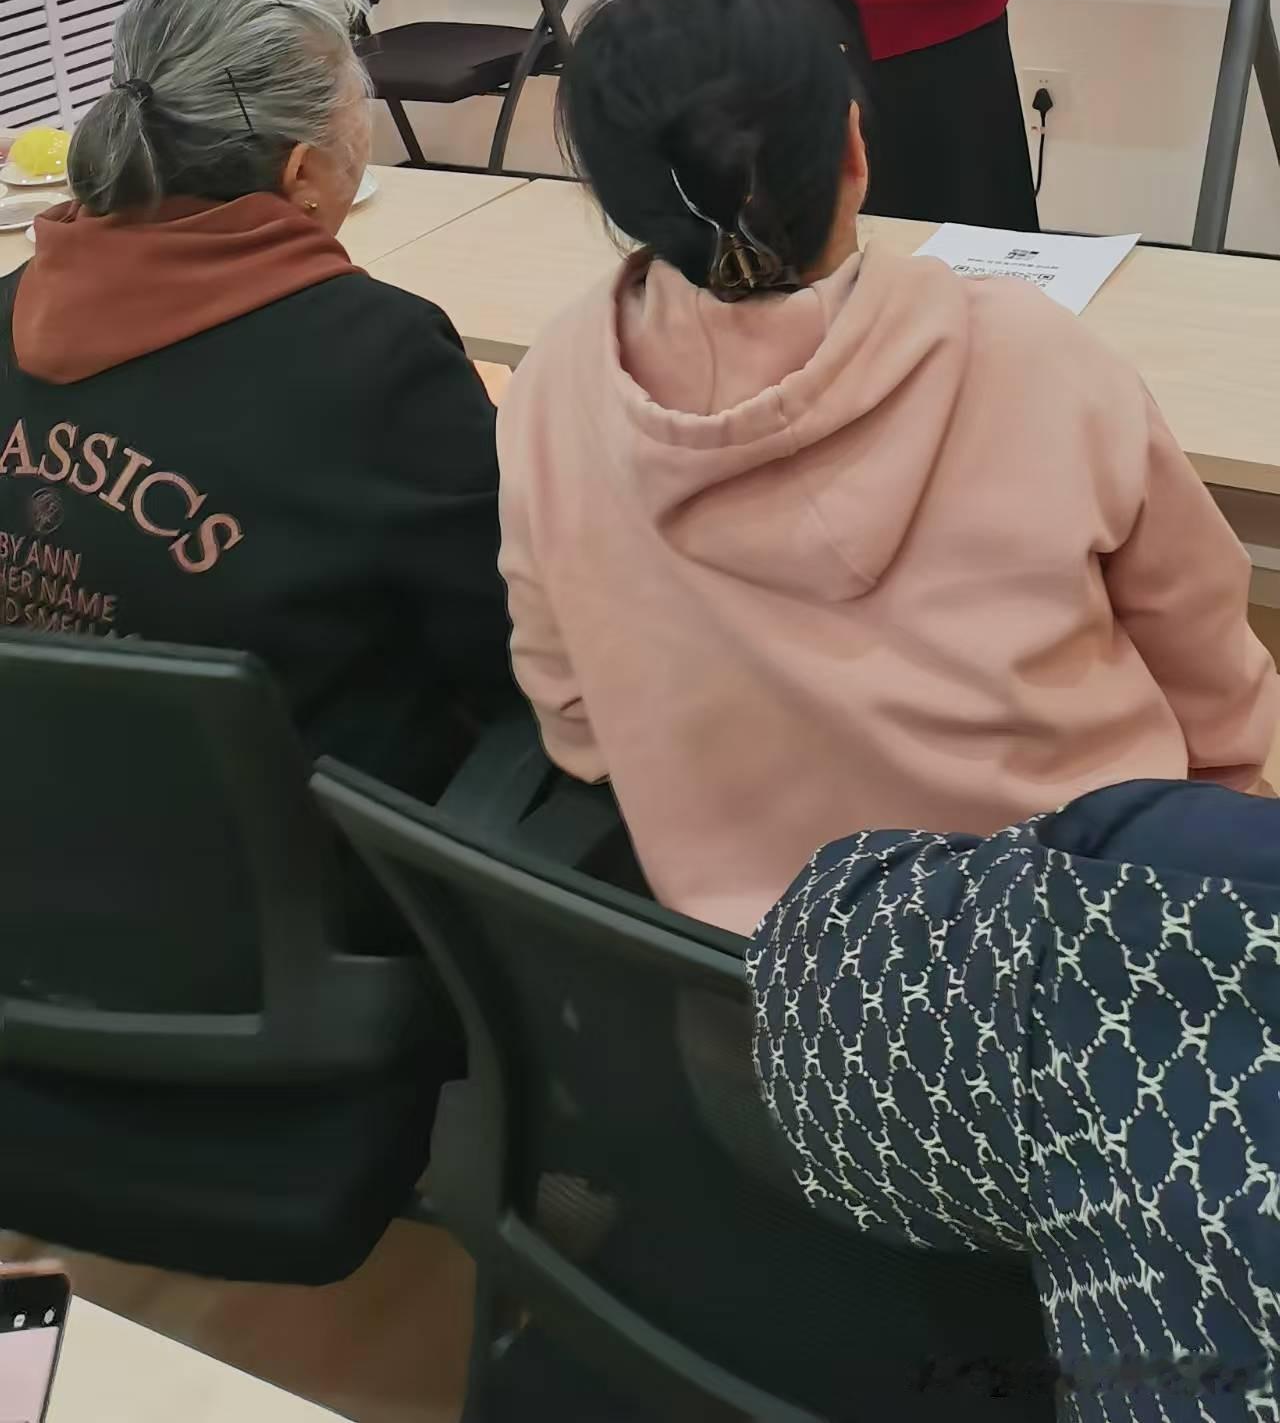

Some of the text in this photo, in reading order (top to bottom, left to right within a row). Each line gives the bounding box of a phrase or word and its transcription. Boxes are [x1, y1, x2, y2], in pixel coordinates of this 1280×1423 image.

[0, 418, 245, 574] ASSICS
[25, 539, 82, 581] ANN
[40, 576, 118, 623] NAME
